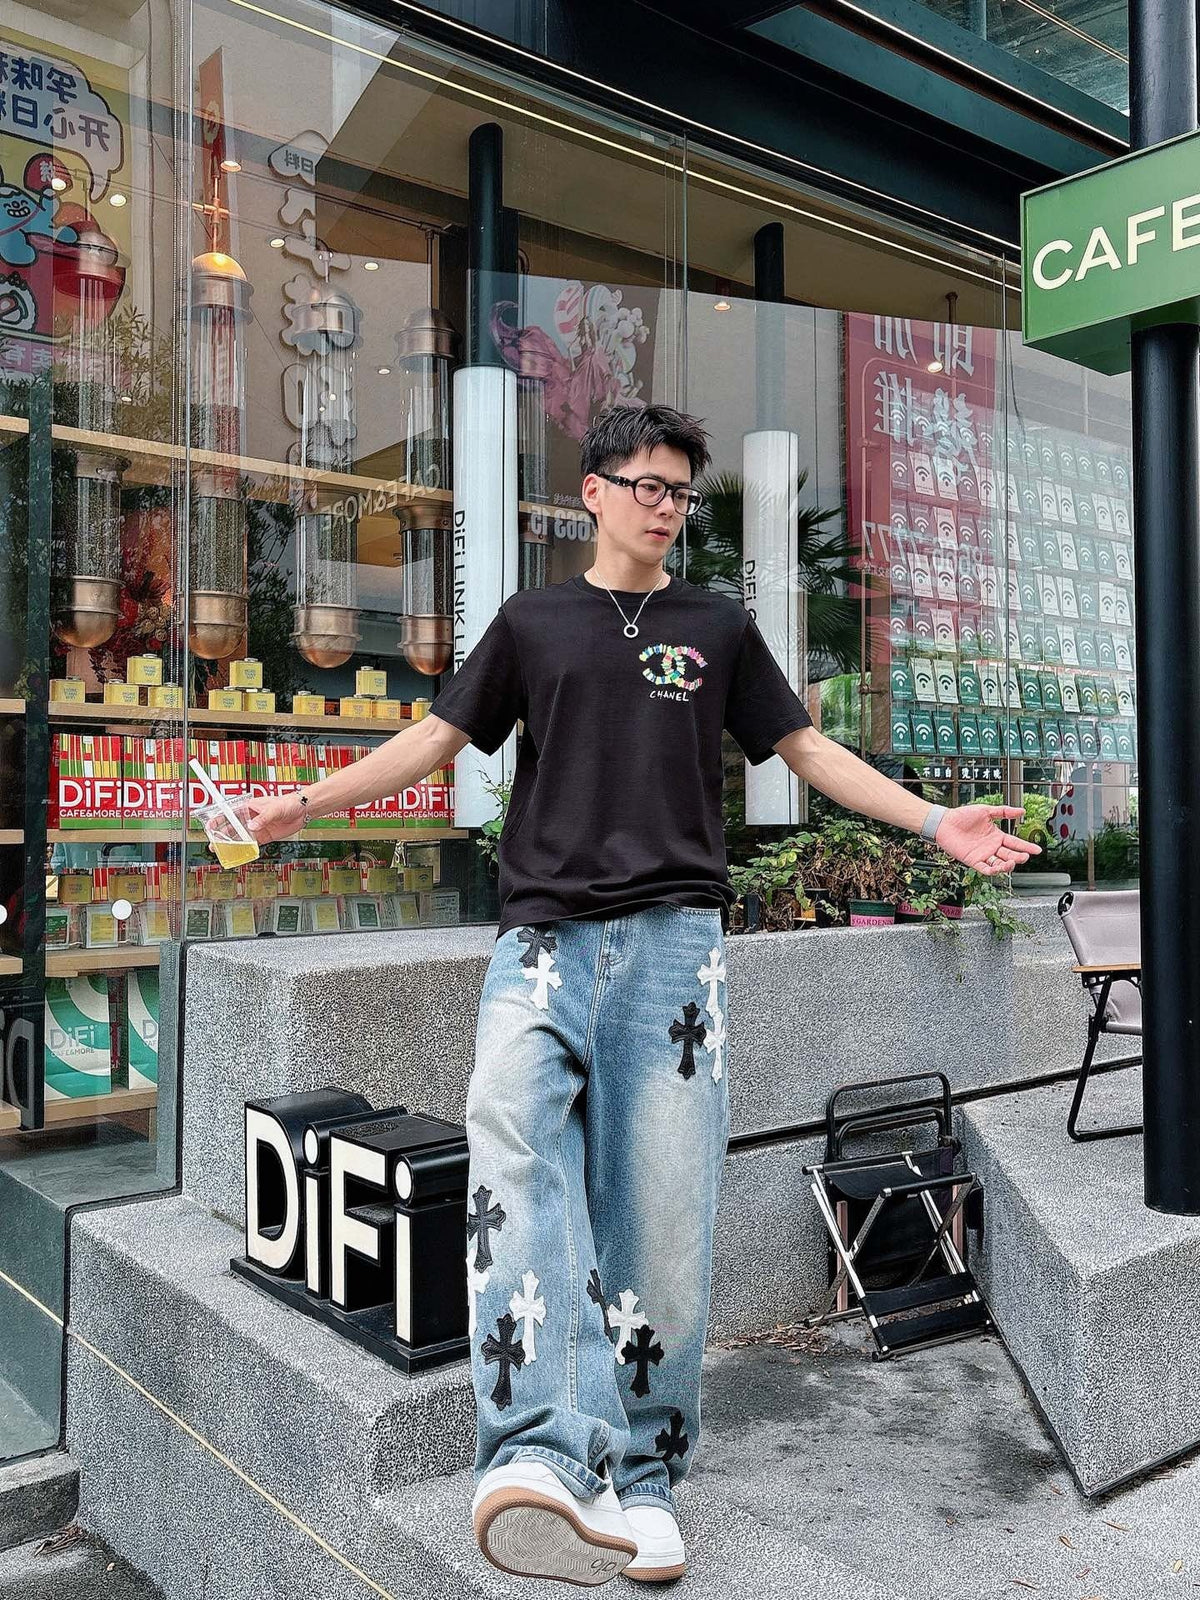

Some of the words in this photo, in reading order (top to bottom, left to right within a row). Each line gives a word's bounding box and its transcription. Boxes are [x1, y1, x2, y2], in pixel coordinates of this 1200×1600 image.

[1032, 193, 1200, 290] CAFE
[454, 510, 466, 556] DiFi
[454, 564, 466, 625] LINK
[744, 560, 757, 601] DiFi
[649, 690, 690, 702] CHANEL
[60, 779, 122, 809] DiFi
[123, 780, 184, 810] DiFi
[403, 786, 449, 810] DiFi
[60, 809, 122, 819] CAFE&MORE
[354, 810, 402, 819] CAFE&MORE
[403, 810, 449, 819] CAFE&MORE
[51, 1024, 96, 1050] DiFi
[246, 1107, 413, 1343] DiFi
